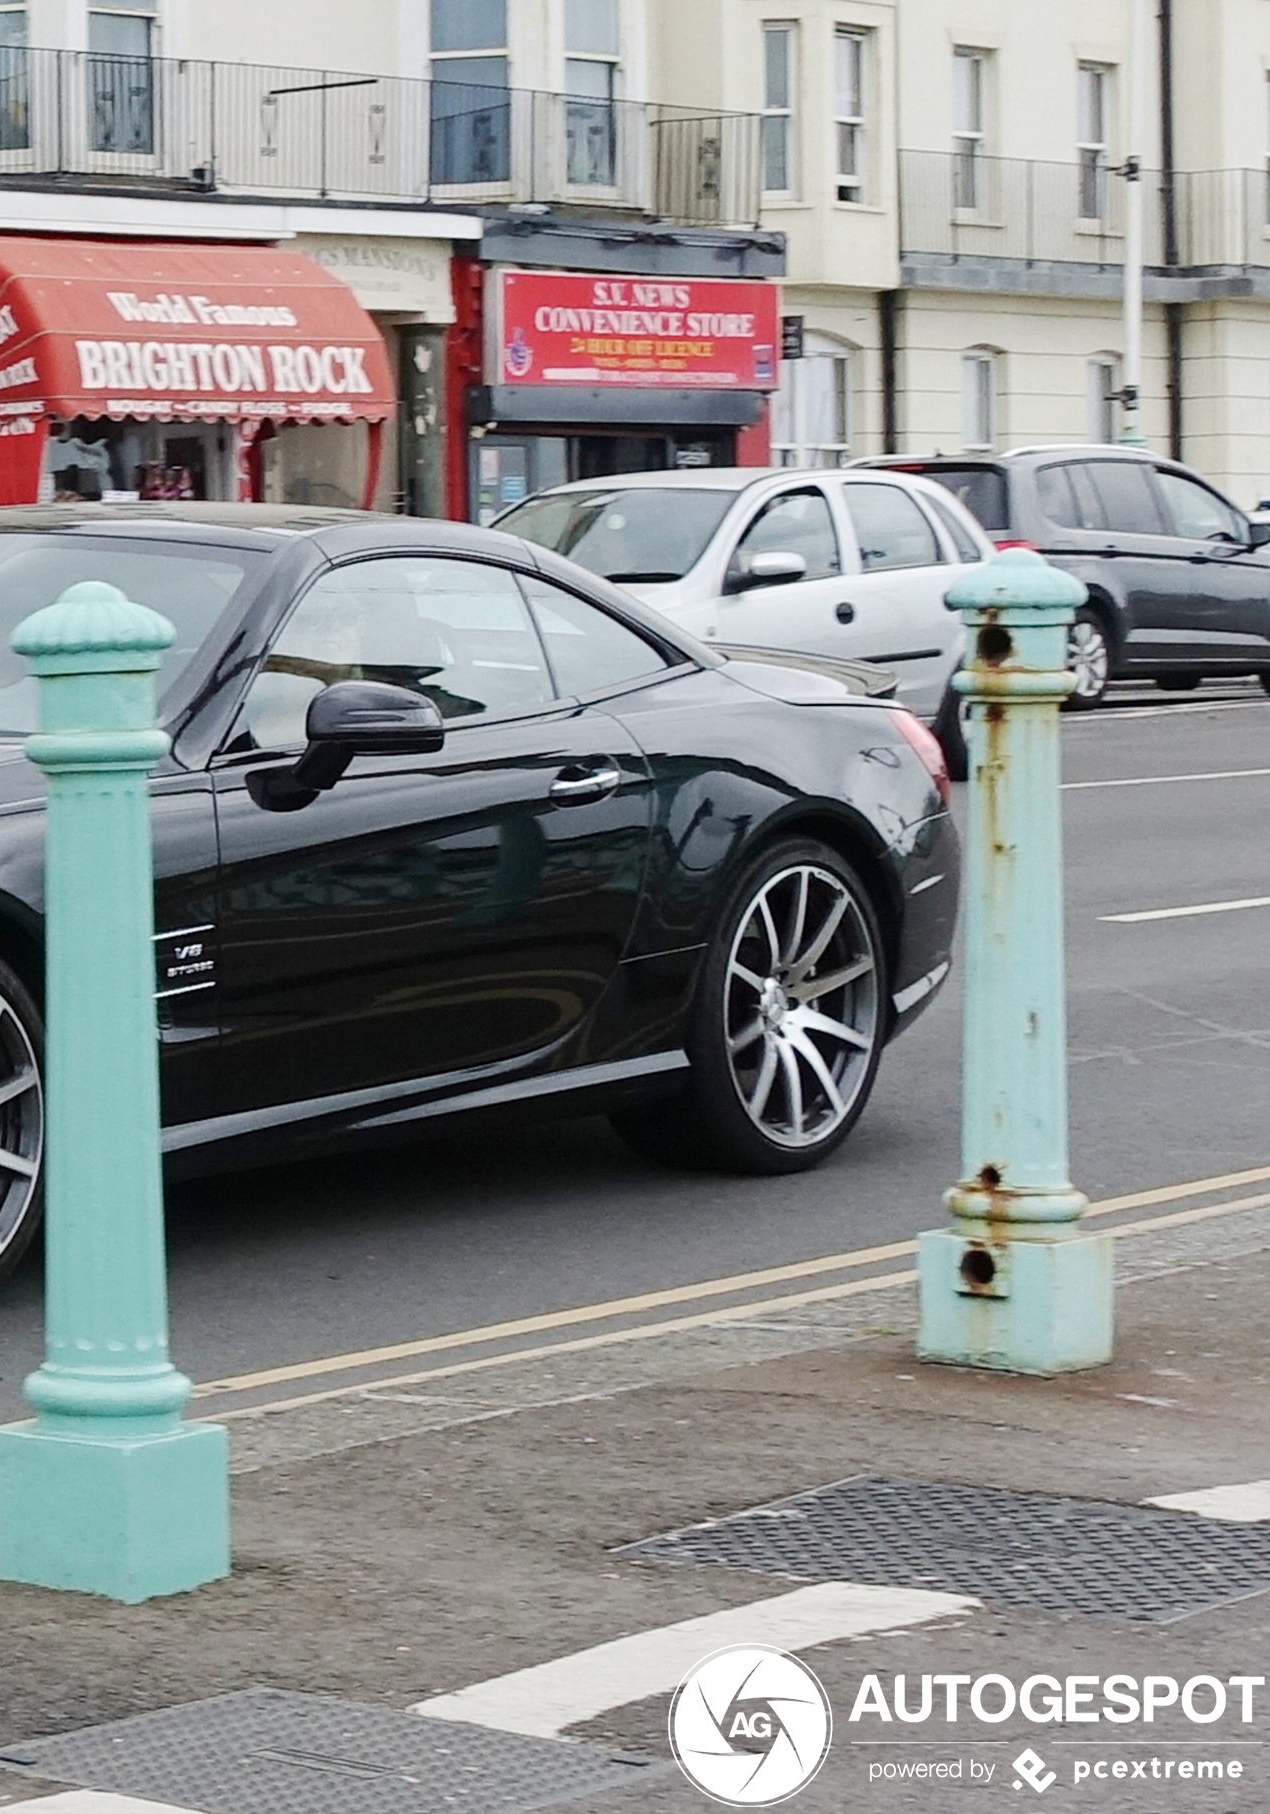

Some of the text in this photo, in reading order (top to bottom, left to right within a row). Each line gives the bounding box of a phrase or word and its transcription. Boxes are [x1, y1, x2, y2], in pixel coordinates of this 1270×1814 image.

[106, 291, 298, 327] World Famous
[630, 284, 690, 310] NEWS
[534, 306, 756, 338] CONVENIENCE STORE
[655, 341, 715, 358] LICENCE
[76, 341, 374, 394] BRIGHTON ROCK
[174, 943, 203, 959] V8
